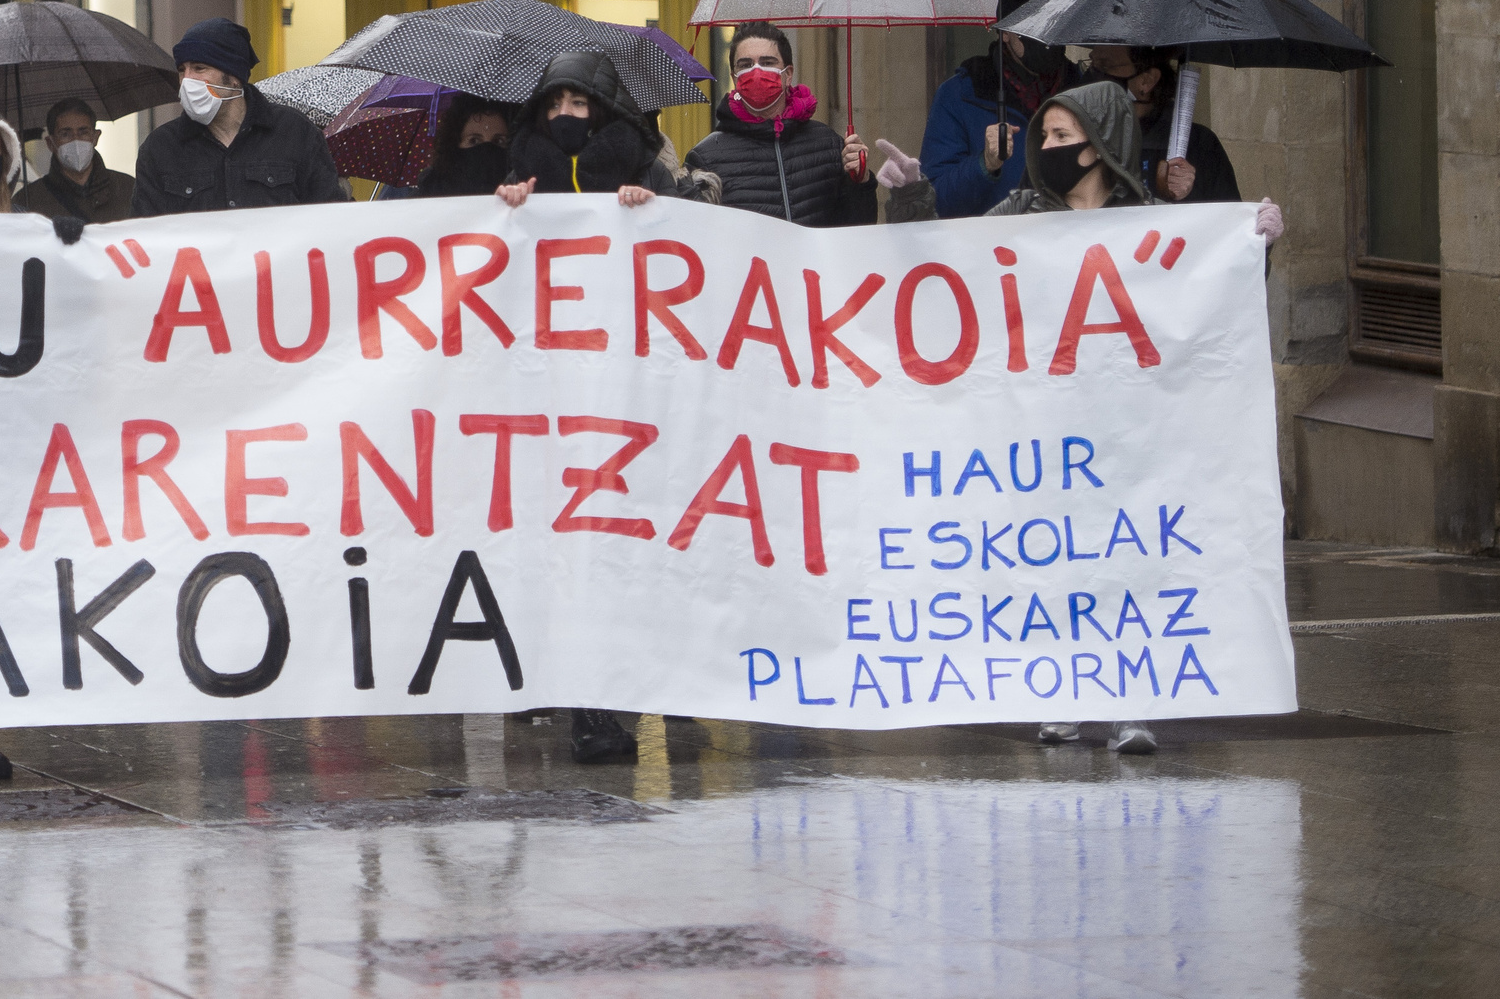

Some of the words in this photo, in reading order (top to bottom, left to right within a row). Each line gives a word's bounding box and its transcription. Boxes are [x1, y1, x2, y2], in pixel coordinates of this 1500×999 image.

[902, 436, 1104, 497] HAUR
[879, 504, 1202, 571] ESKOLAK
[846, 587, 1211, 643] EUSKARAZ
[739, 643, 1219, 708] PLATAFORMA
